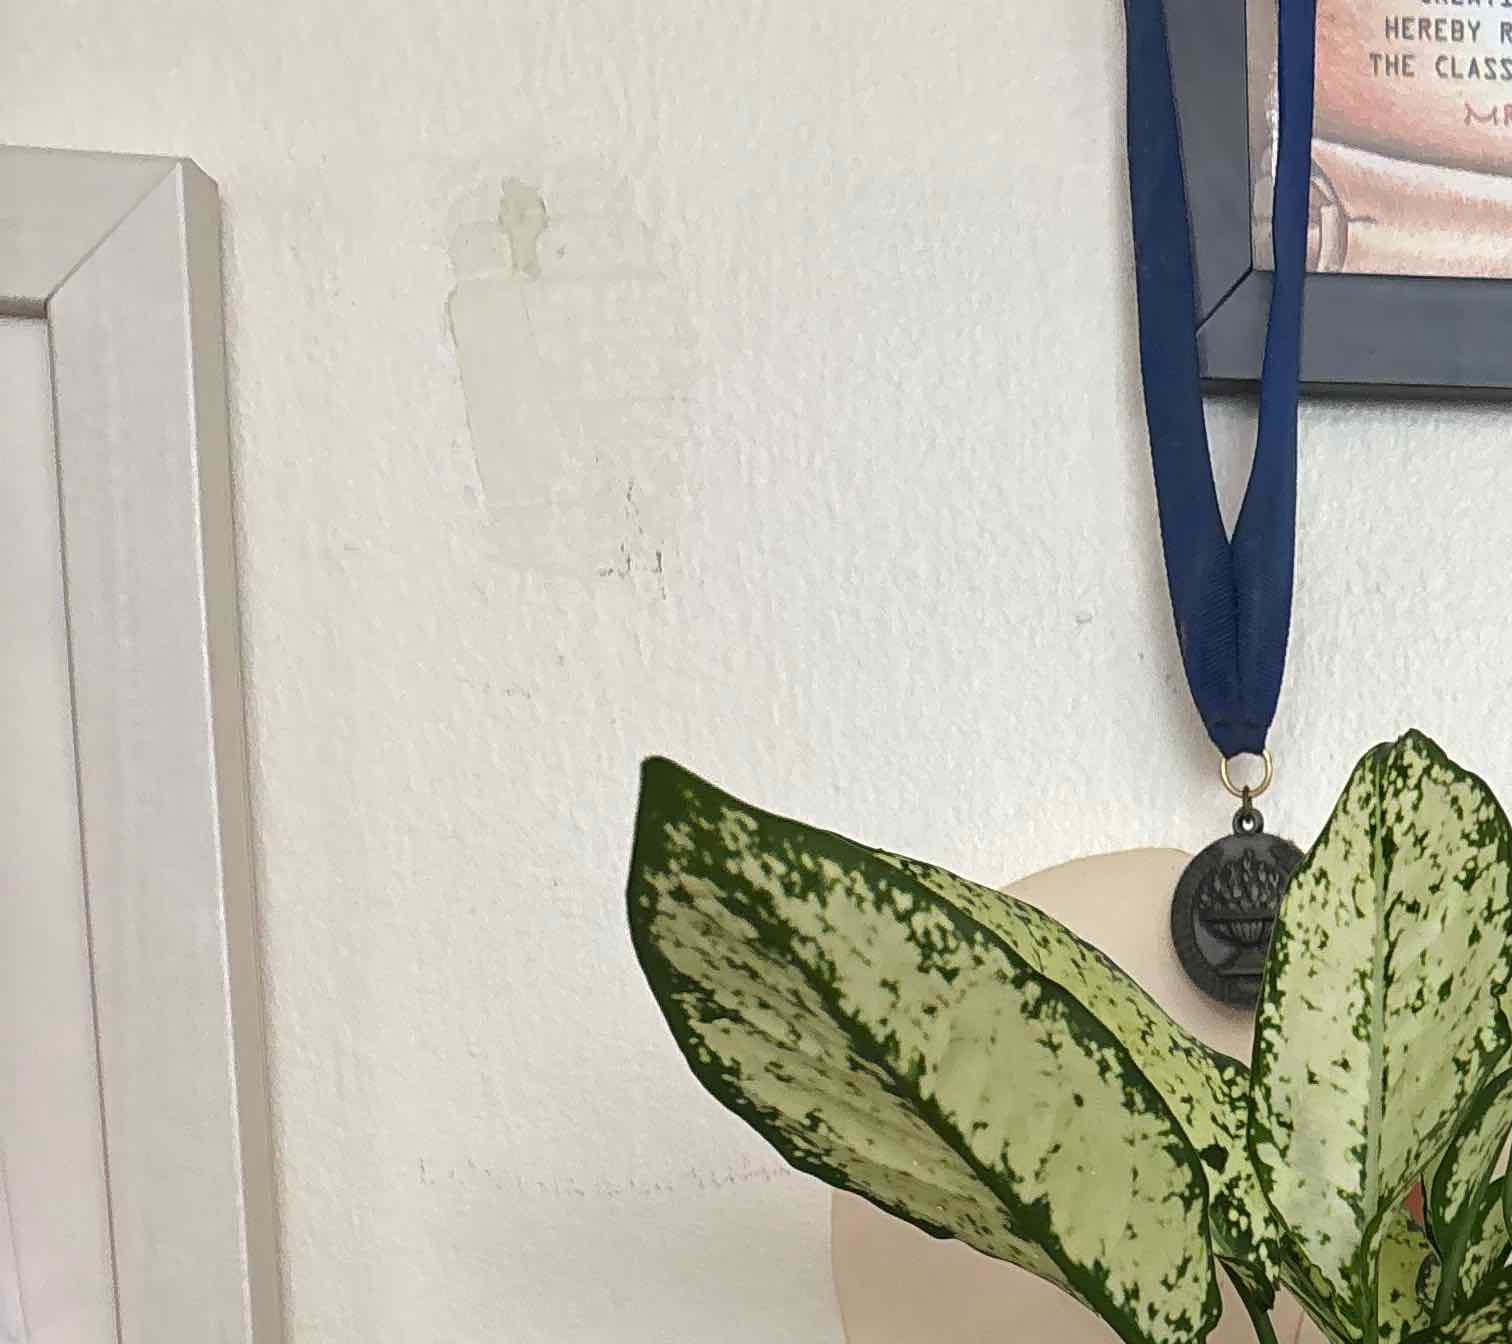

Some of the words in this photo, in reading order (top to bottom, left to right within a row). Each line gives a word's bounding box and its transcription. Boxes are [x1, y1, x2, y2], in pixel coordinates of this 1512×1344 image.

[1385, 16, 1480, 42] HEREBY
[1369, 53, 1415, 77] THE
[1435, 55, 1512, 80] CLASS
